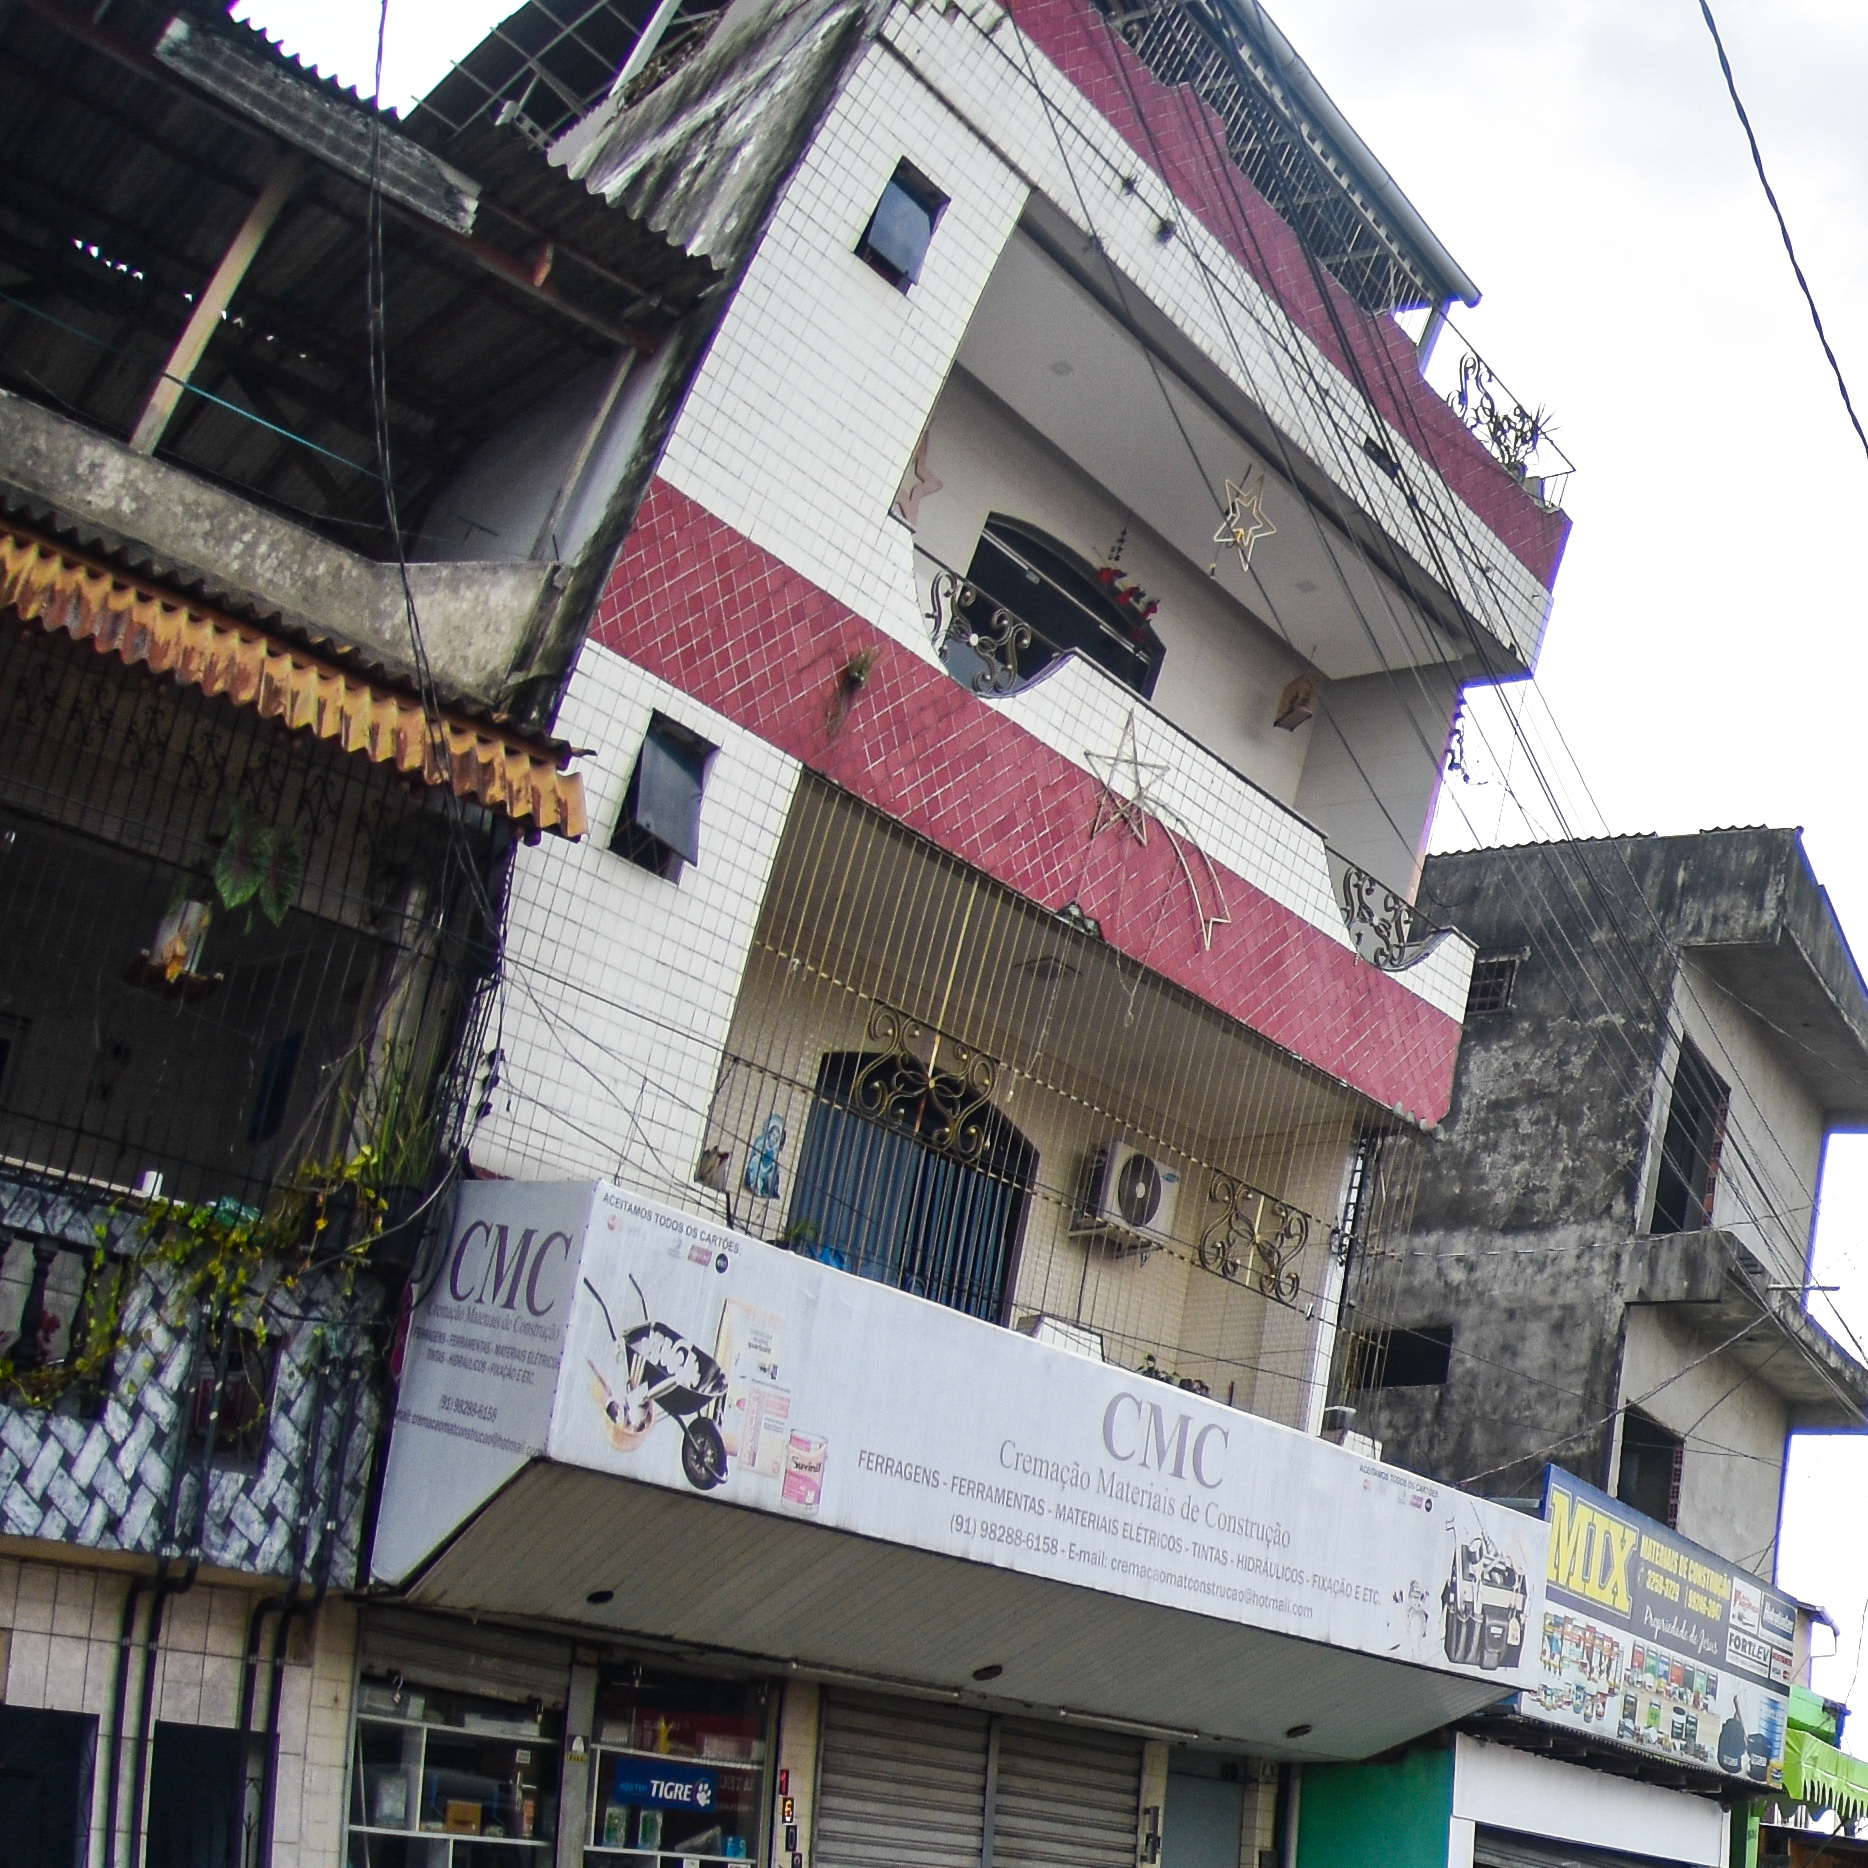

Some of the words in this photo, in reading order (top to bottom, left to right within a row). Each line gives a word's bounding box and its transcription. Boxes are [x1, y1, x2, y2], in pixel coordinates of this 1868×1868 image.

[603, 1192, 652, 1221] ACEITAMOS
[654, 1213, 684, 1234] TODOS
[686, 1225, 697, 1238] OS
[450, 1220, 574, 1317] CMC
[791, 1455, 822, 1474] Suvinil
[1102, 1391, 1230, 1490] CMC
[858, 1449, 940, 1489] FERRAGENS
[950, 1475, 1046, 1516] FERRAMENTAS
[1055, 1503, 1119, 1536] MATERIAIS
[1122, 1516, 1183, 1554] ELÉTRICOS
[1192, 1541, 1228, 1566] TINTAS
[1236, 1553, 1305, 1585] HIDRÁULICOS
[1312, 1573, 1352, 1600] FIXAÇÃO
[1354, 1584, 1361, 1600] E
[1362, 1585, 1381, 1606] ETC.
[1000, 1440, 1091, 1492] Cremação
[1096, 1467, 1175, 1517] Materiais
[1180, 1495, 1200, 1523] de
[1205, 1501, 1291, 1550] Construção
[950, 1514, 976, 1539] (91)
[980, 1520, 1059, 1556] 98288-6158
[1068, 1543, 1108, 1568] E-mail:
[1110, 1556, 1314, 1618] cremacaomatconstrucao@hotmail.com
[1547, 1488, 1638, 1616] MIX
[1640, 1535, 1678, 1575] MATERIAIS
[1679, 1555, 1688, 1580] DE
[1644, 1605, 1687, 1640] Propriedade
[1698, 1627, 1718, 1654] Jesus
[1729, 1631, 1769, 1661] FORTLEV
[650, 1779, 692, 1802] TIGRE
